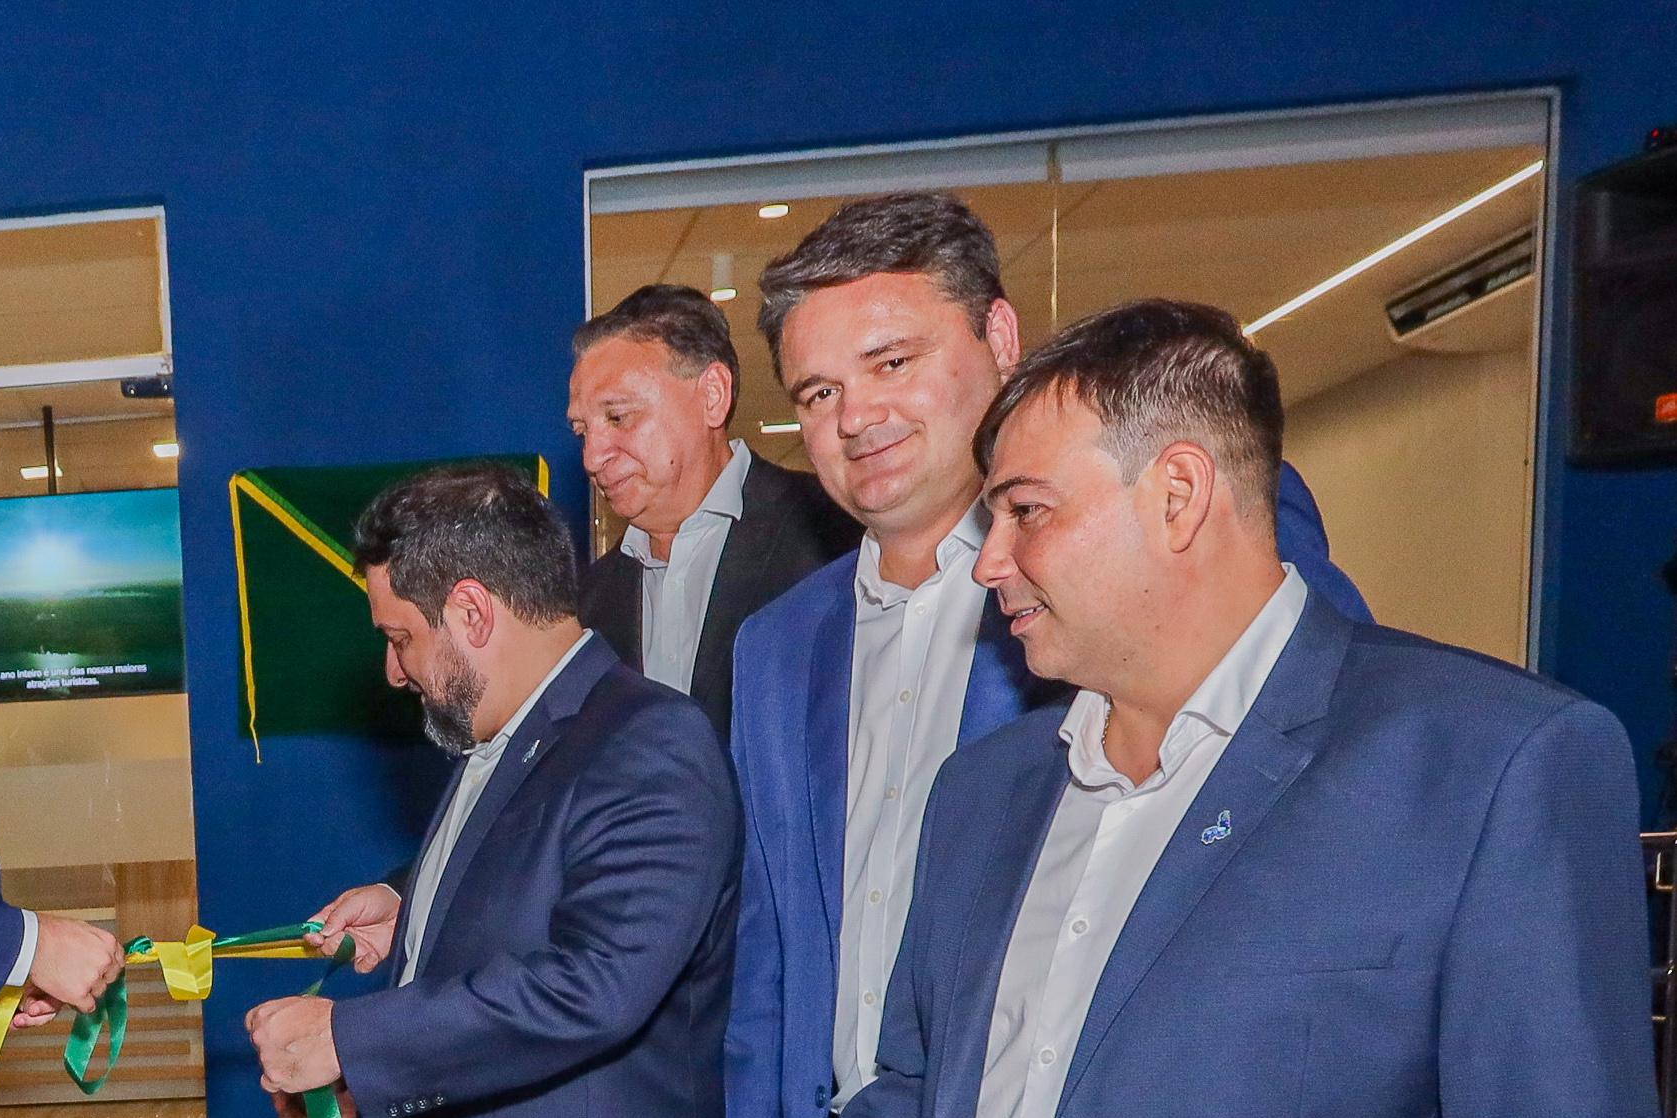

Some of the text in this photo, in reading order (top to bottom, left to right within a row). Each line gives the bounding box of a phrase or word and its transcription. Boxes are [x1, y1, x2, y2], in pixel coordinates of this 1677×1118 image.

[0, 671, 16, 680] ano
[17, 669, 42, 679] inteiro
[52, 667, 69, 676] uma
[70, 666, 85, 675] das
[86, 666, 113, 675] nossas
[115, 664, 147, 673] maiores
[26, 677, 99, 690] atrações turísticas.
